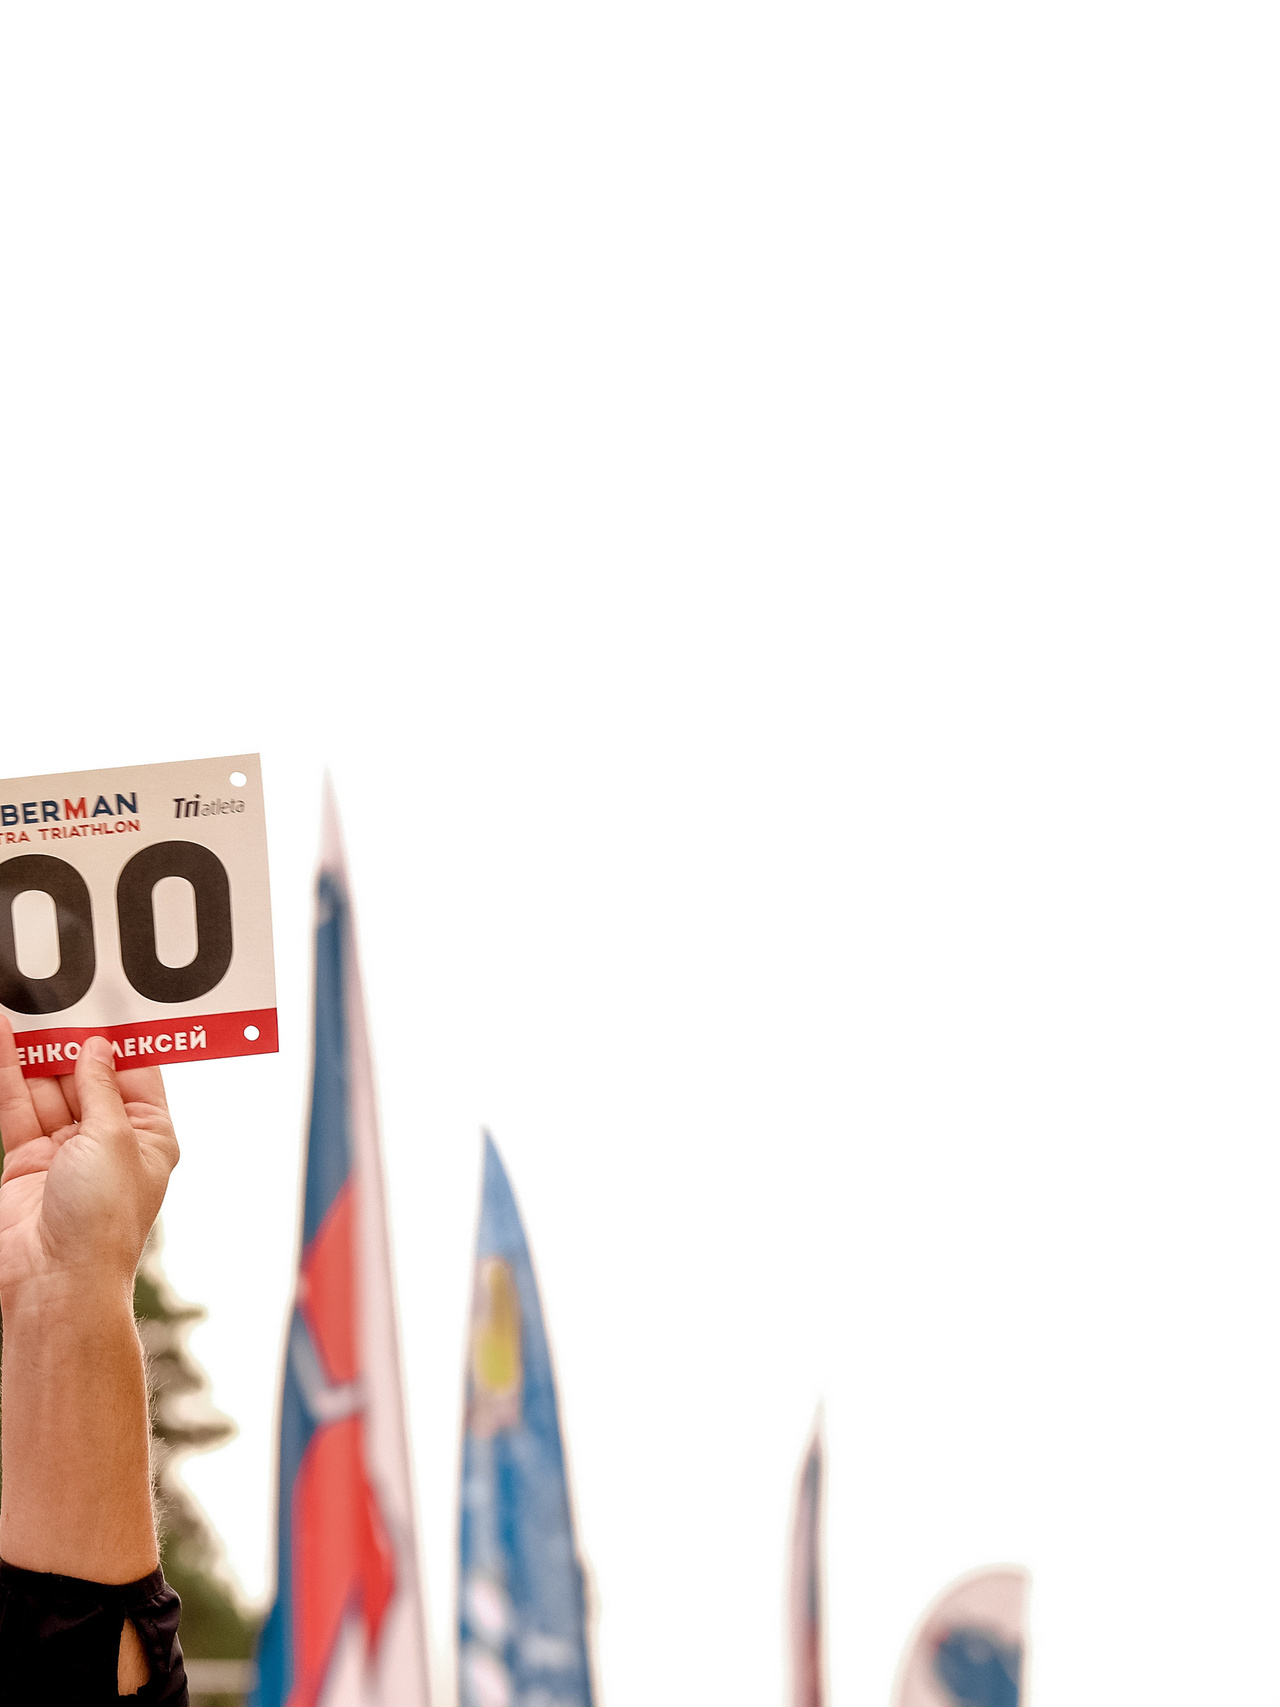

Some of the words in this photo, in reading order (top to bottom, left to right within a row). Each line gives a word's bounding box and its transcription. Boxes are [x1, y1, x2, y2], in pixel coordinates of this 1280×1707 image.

[173, 794, 246, 819] Triatleta
[37, 819, 142, 841] TRIATHLON
[109, 1024, 207, 1058] ЛЕКСЕЙ
